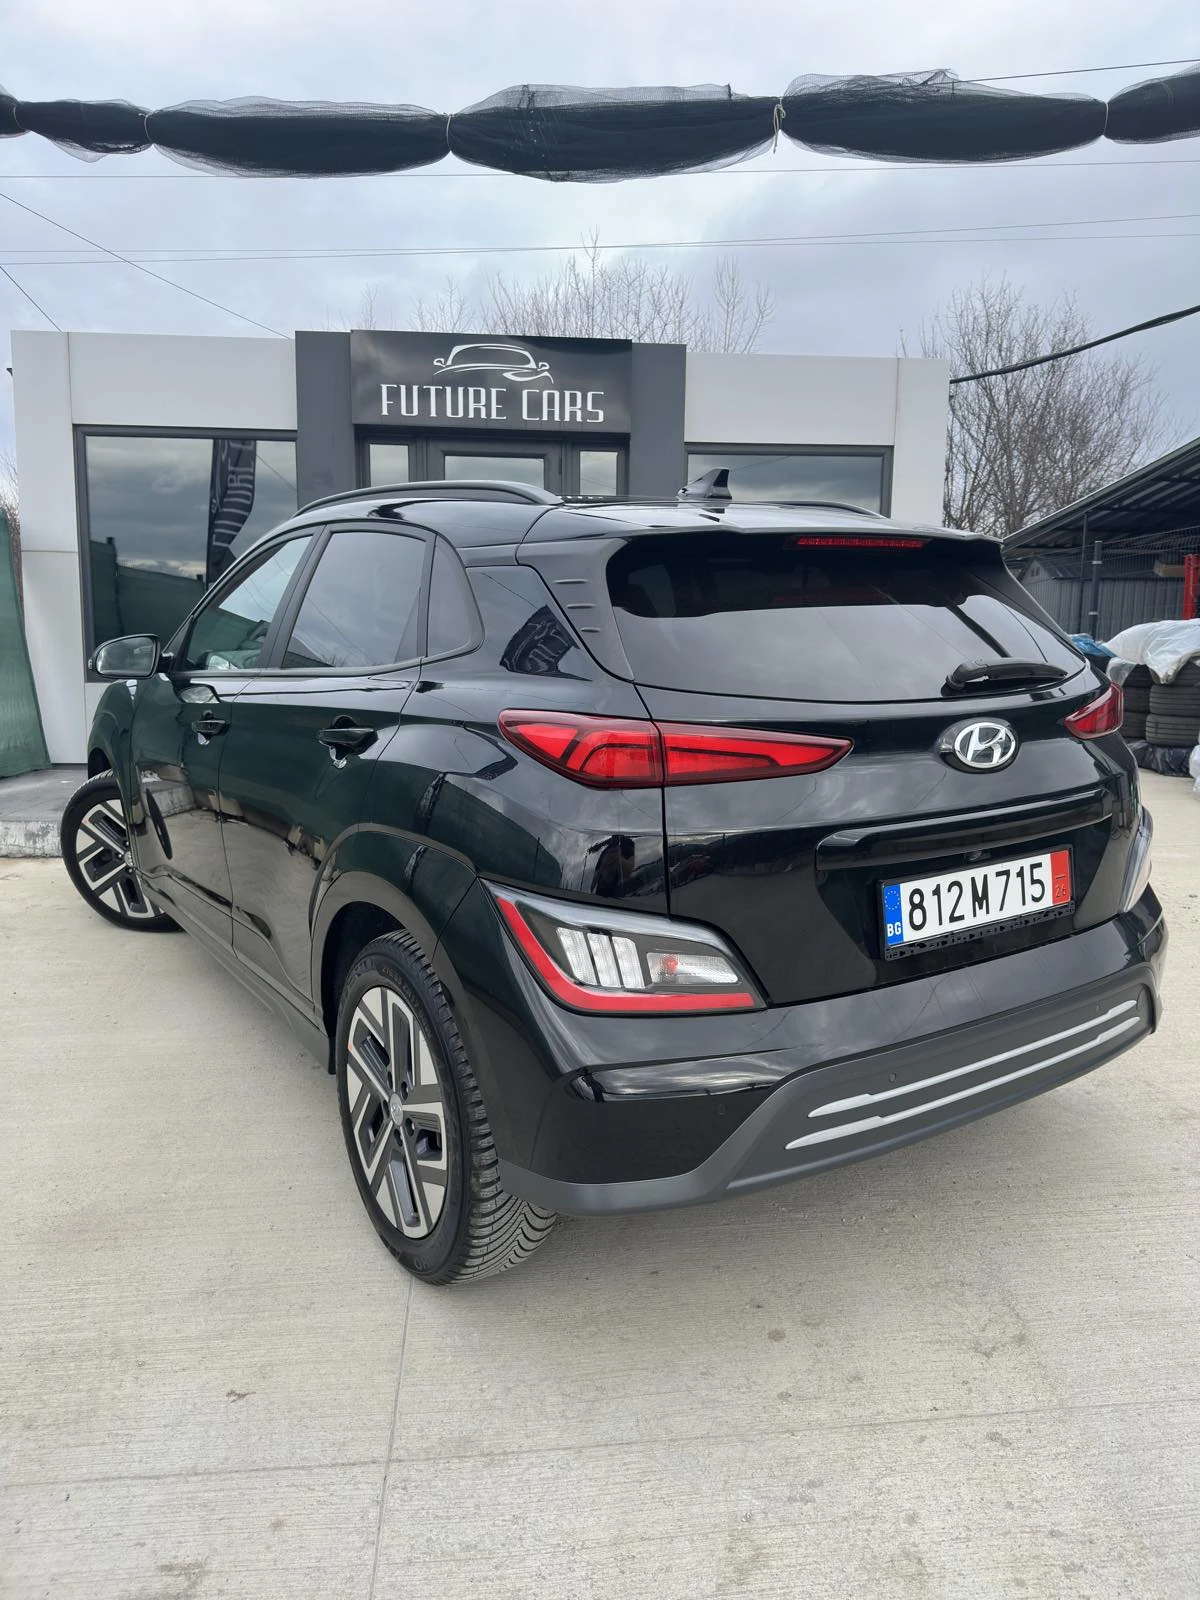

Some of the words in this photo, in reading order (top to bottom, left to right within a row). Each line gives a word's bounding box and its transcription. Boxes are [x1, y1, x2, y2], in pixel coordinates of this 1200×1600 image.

[380, 384, 507, 420] FUTURE
[522, 389, 605, 423] CARS
[887, 921, 902, 937] BG
[908, 862, 1046, 931] 812M715
[1055, 883, 1067, 898] 26
